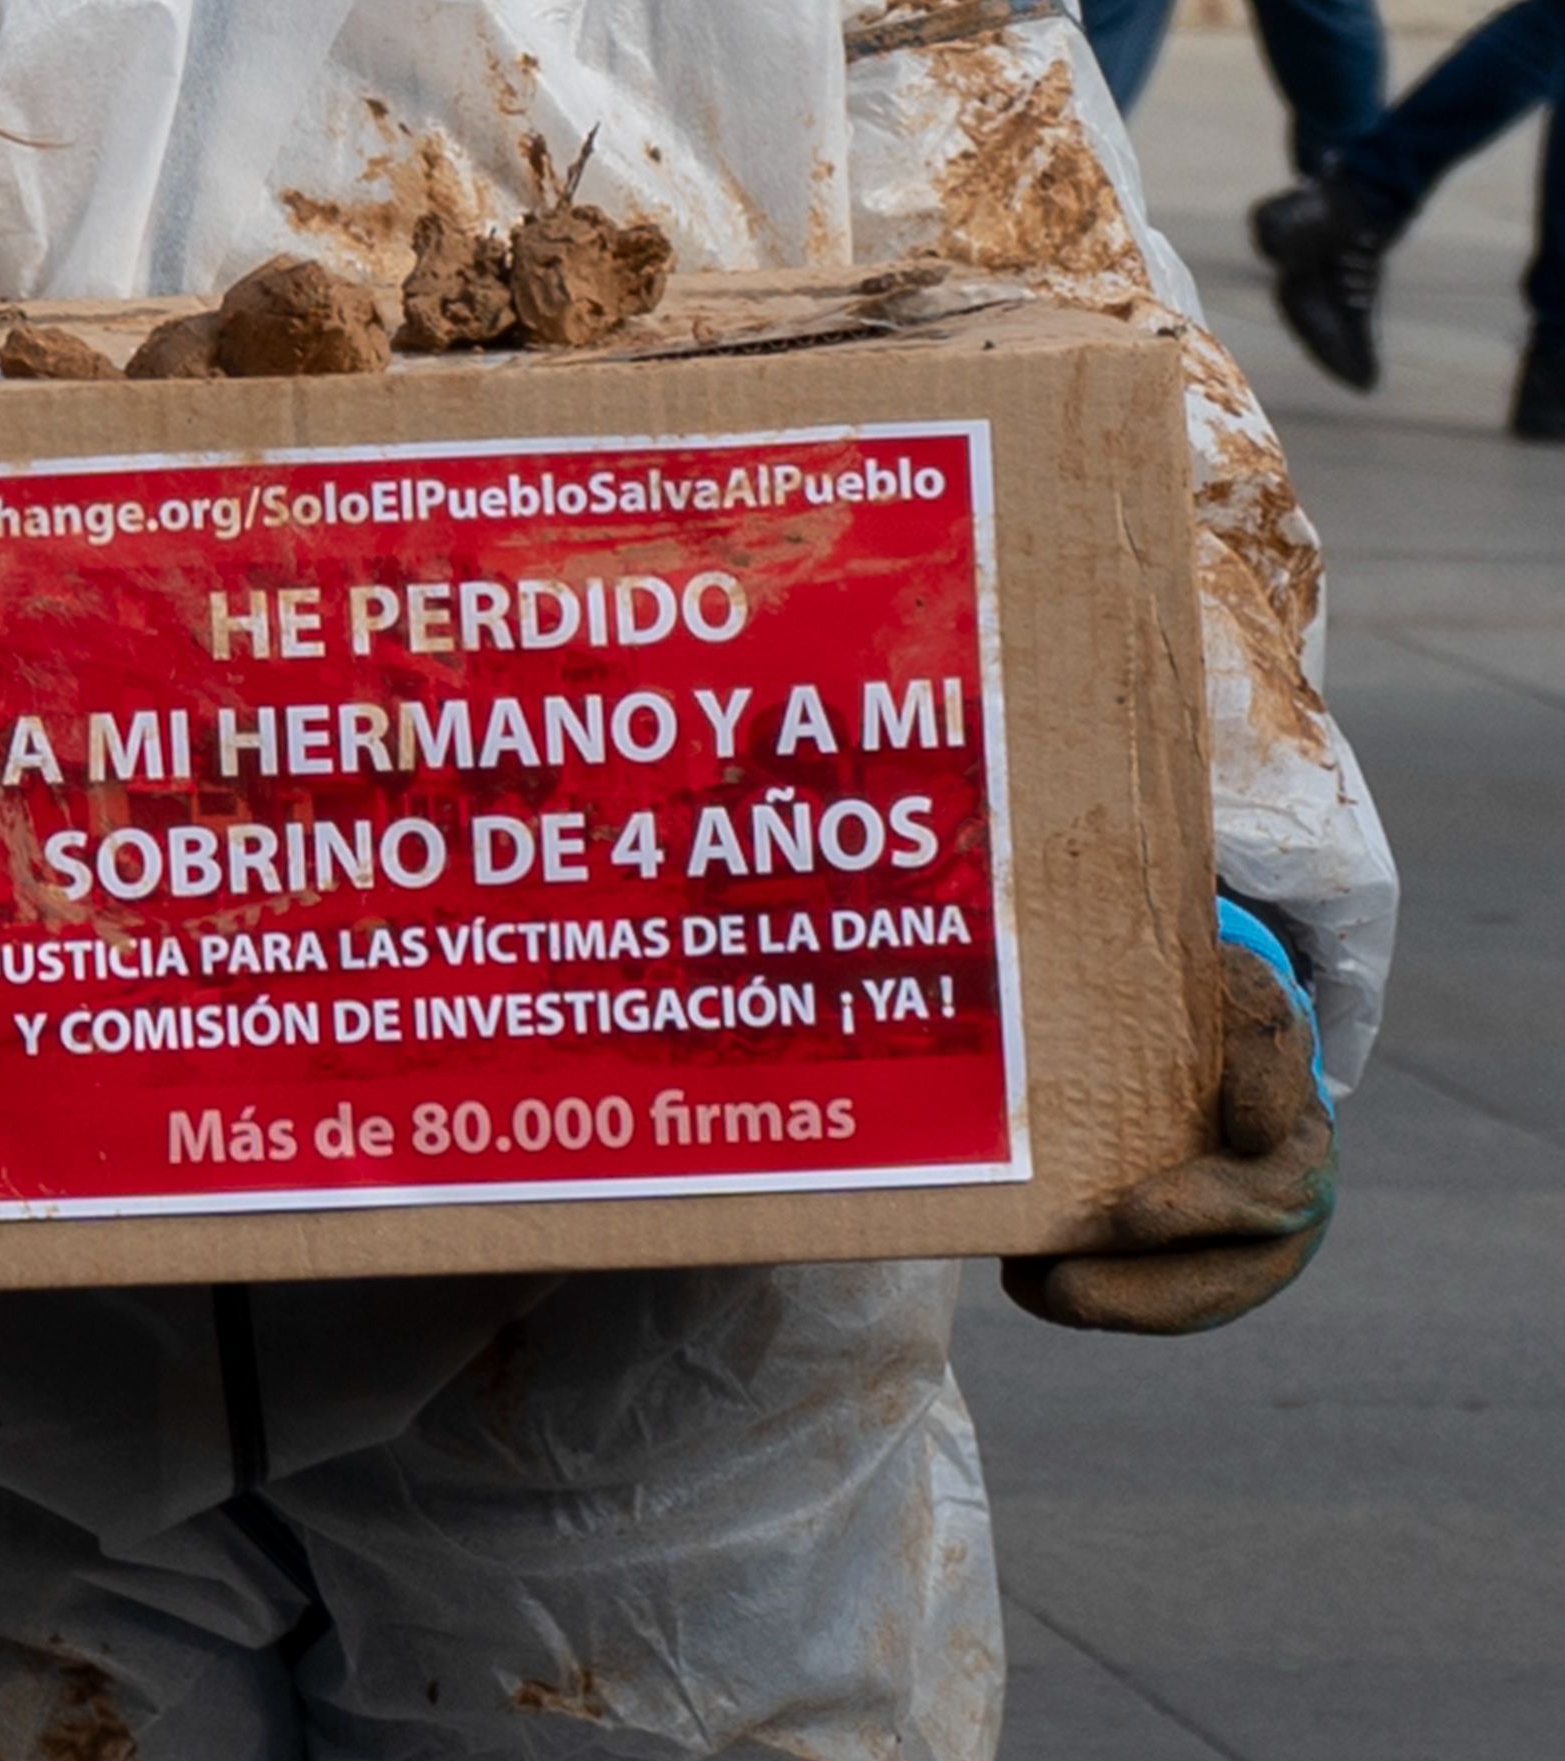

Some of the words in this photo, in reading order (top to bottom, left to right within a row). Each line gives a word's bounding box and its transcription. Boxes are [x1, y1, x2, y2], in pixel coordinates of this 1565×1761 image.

[209, 587, 326, 661] HE
[349, 569, 748, 656] PERDIDO
[1, 715, 64, 786] A
[88, 709, 191, 782] MI
[217, 691, 678, 777] HERMANO
[693, 687, 753, 758] Y
[776, 684, 838, 756] A
[862, 676, 965, 751] MI
[43, 817, 447, 904] SOBRINO
[472, 812, 589, 885] DE
[610, 810, 665, 879] 4
[687, 786, 939, 877] AÑOS
[200, 931, 328, 975] PARA
[339, 926, 429, 970] LAS
[436, 916, 671, 966] VÍCTIMAS
[682, 915, 747, 957] DE
[758, 912, 820, 954] LA
[831, 904, 972, 951] DANA
[14, 1012, 48, 1056] Y
[60, 994, 320, 1054] COMISIÓN
[333, 998, 402, 1043] DE
[414, 975, 816, 1040] INVESTIGACIÓN
[169, 1106, 298, 1164] Más
[314, 1102, 395, 1159] de
[412, 1095, 634, 1155] 80.000
[649, 1088, 856, 1146] firmas
